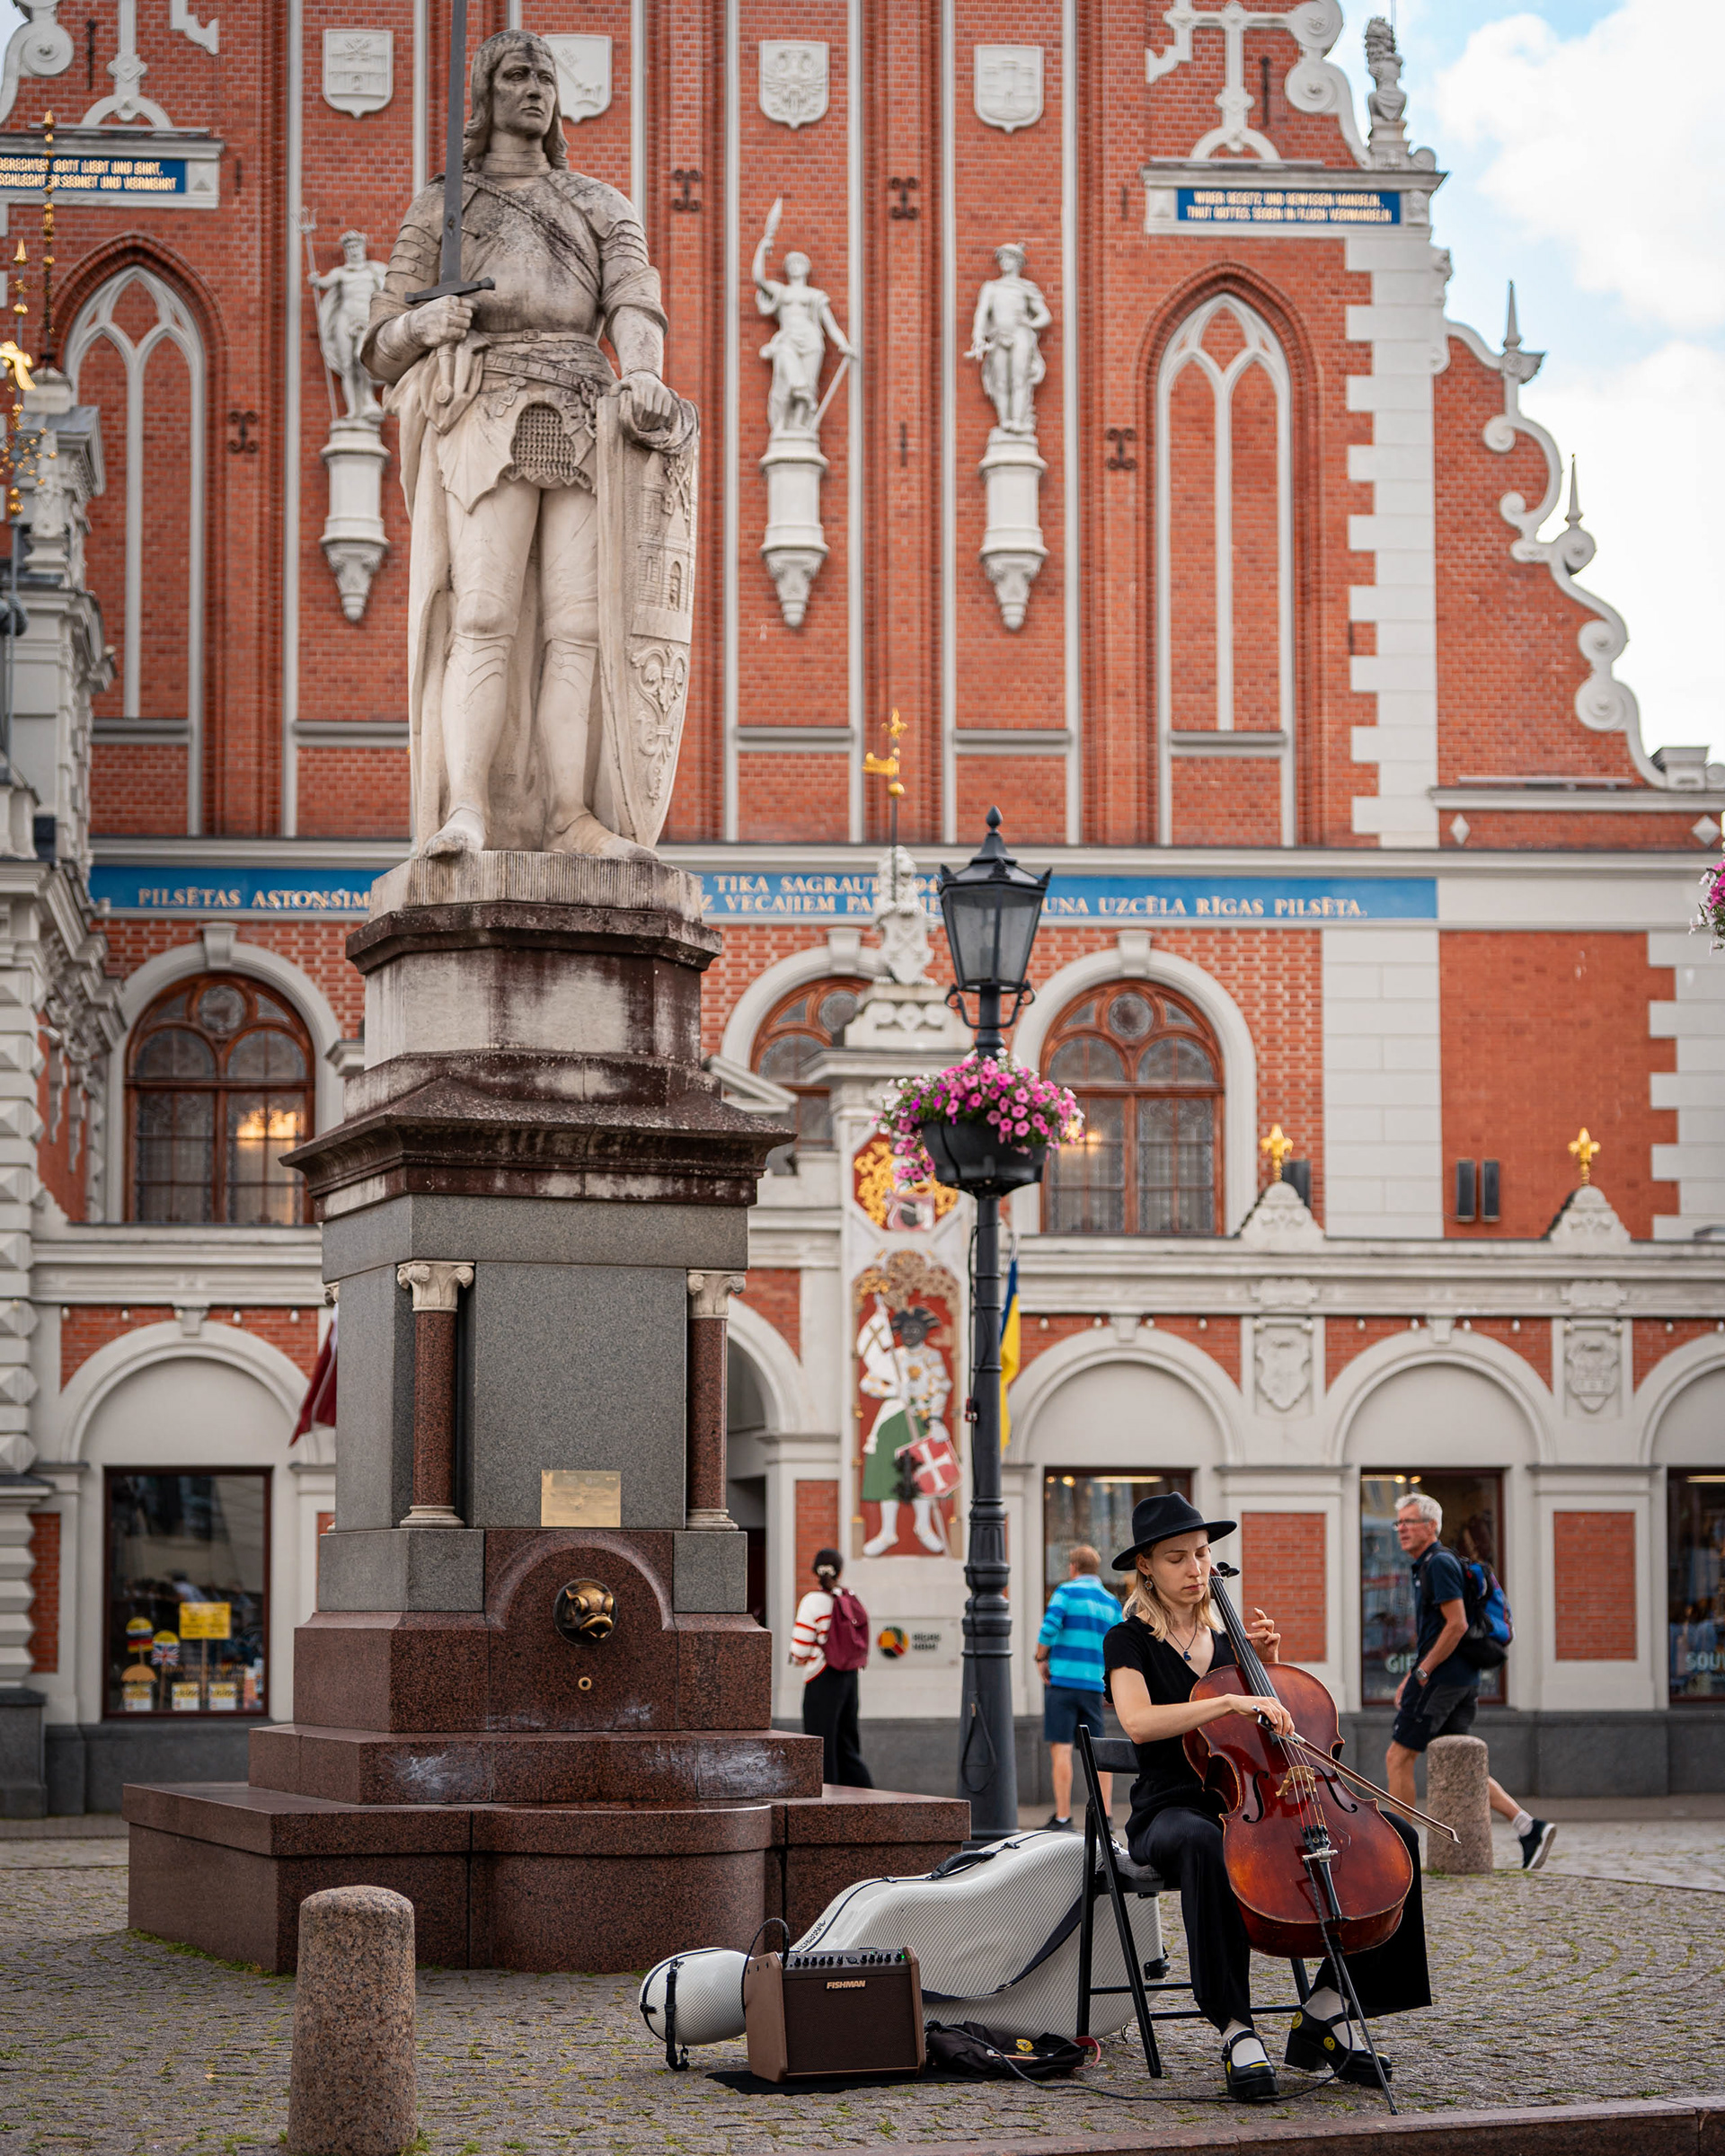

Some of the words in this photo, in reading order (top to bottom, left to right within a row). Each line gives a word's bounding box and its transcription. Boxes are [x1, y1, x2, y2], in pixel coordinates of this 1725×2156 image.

[111, 161, 133, 175] UND
[101, 176, 122, 190] UND
[713, 875, 769, 893] TIKA
[781, 876, 880, 895] SAGRAUT
[138, 887, 241, 907] PILSĒTAS
[725, 895, 836, 914] VECAJIEM
[1098, 895, 1187, 916] UZCĒLA
[1196, 896, 1264, 916] RĪGAS
[1385, 1653, 1419, 1674] GIF
[1685, 1651, 1725, 1671] SOU
[827, 1980, 866, 1990] FISHMAN
